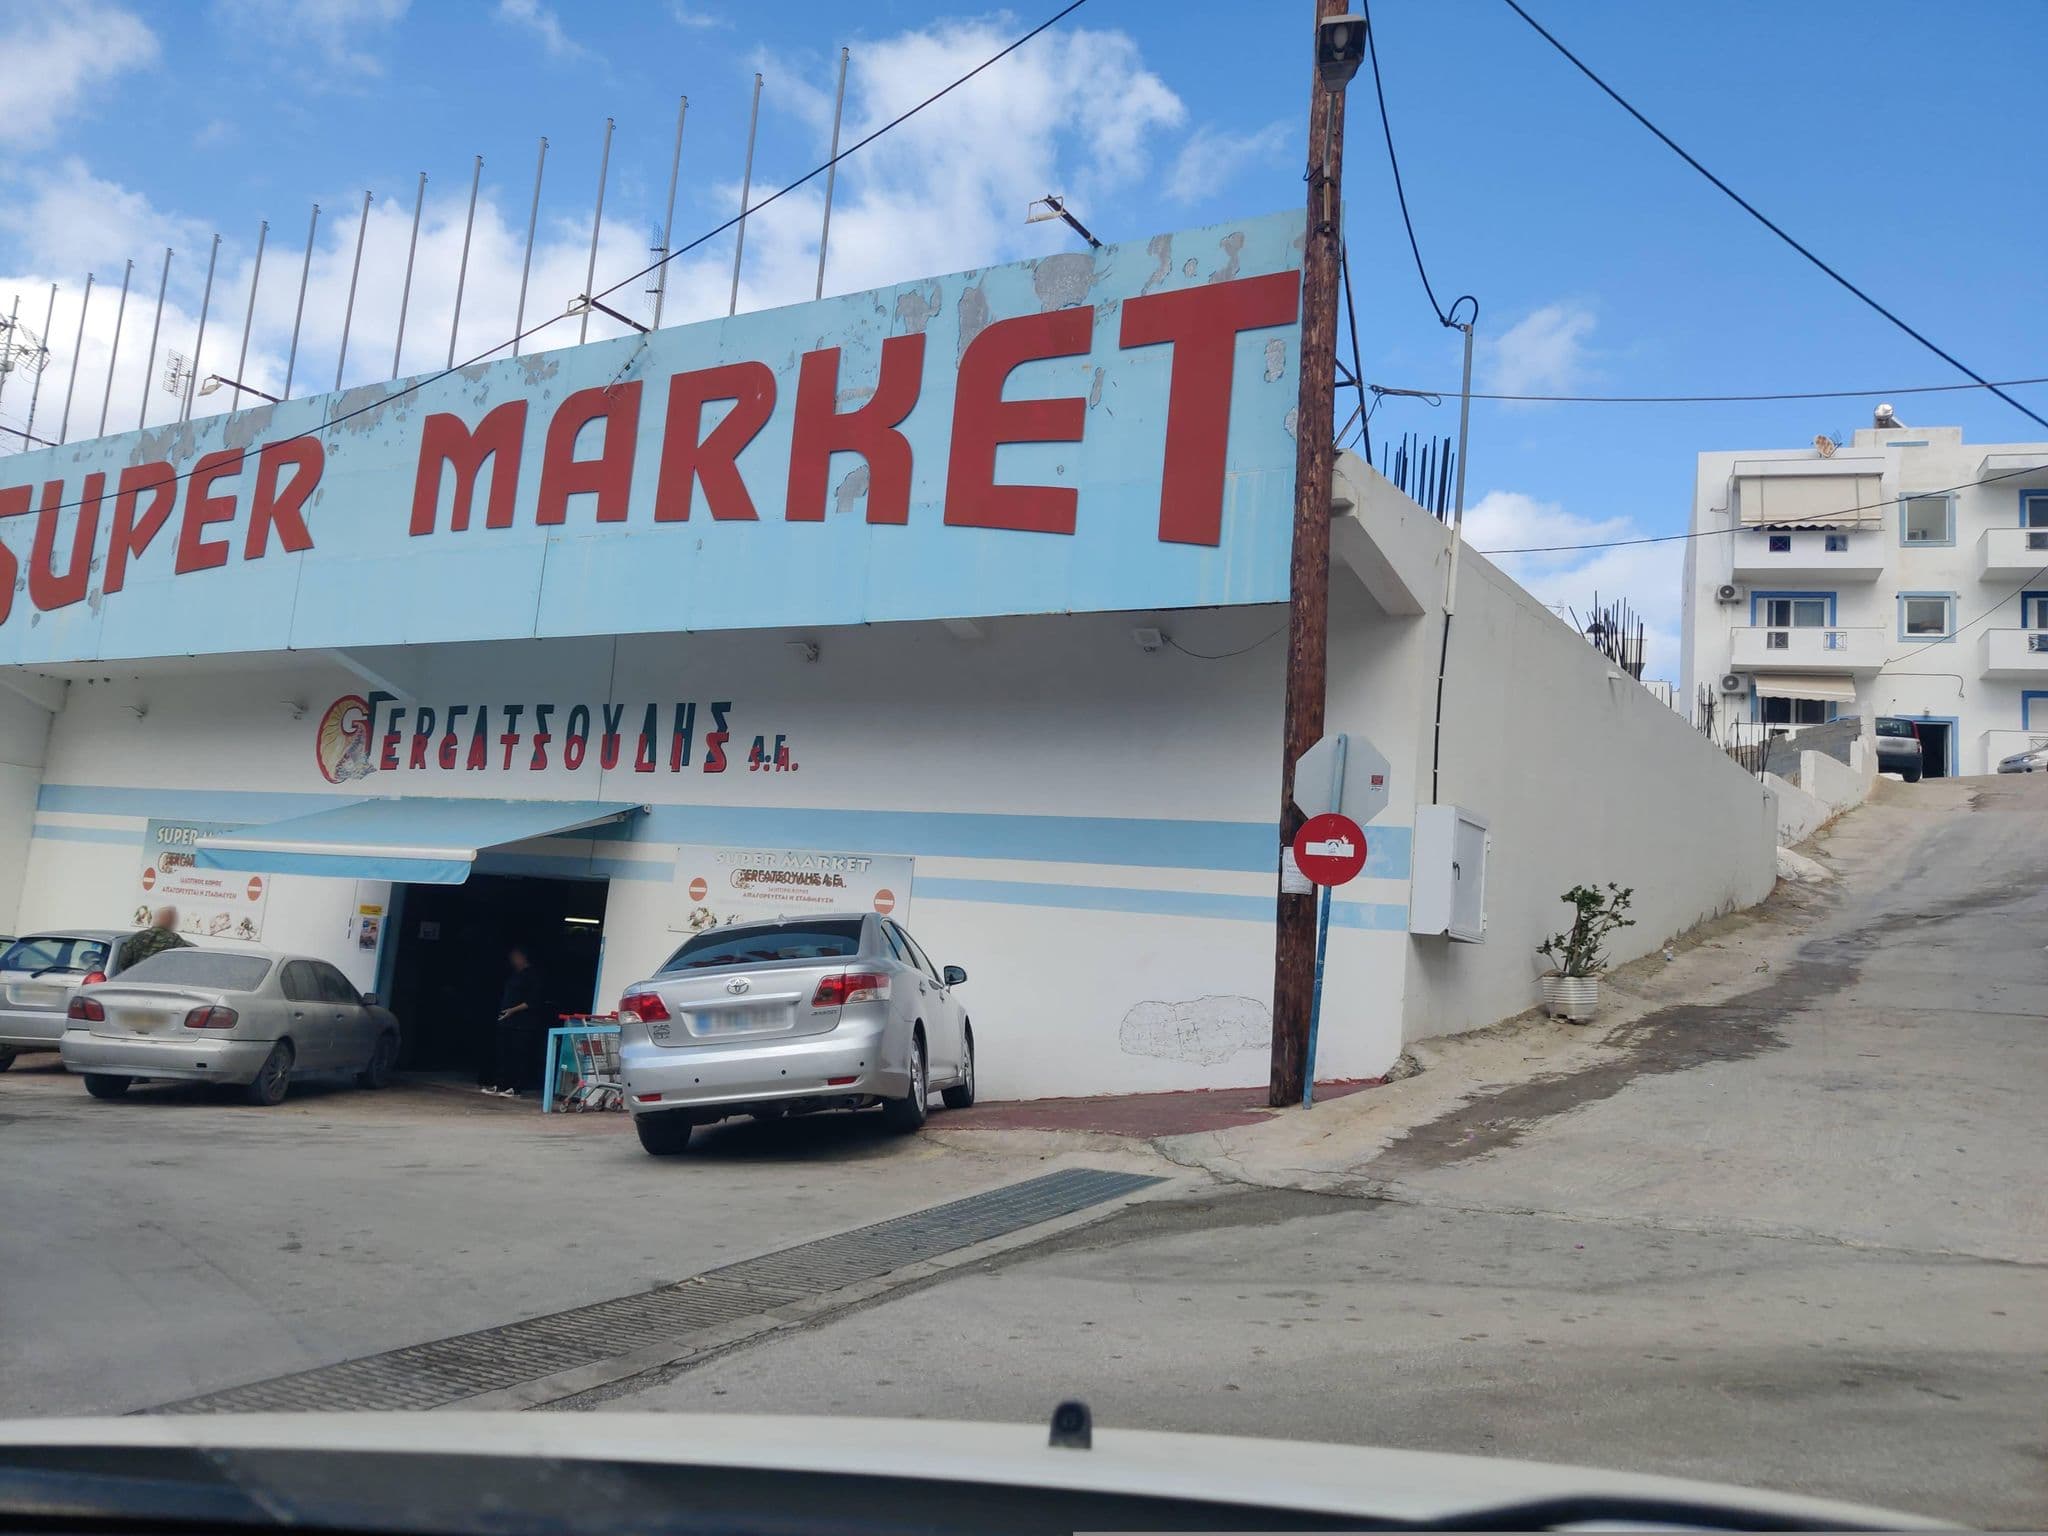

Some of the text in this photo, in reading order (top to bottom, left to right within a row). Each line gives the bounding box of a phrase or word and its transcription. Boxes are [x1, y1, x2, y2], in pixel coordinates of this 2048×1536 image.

[409, 269, 1301, 546] MARKET
[157, 826, 199, 845] SUPER
[715, 850, 873, 874] SUPER MARKET
